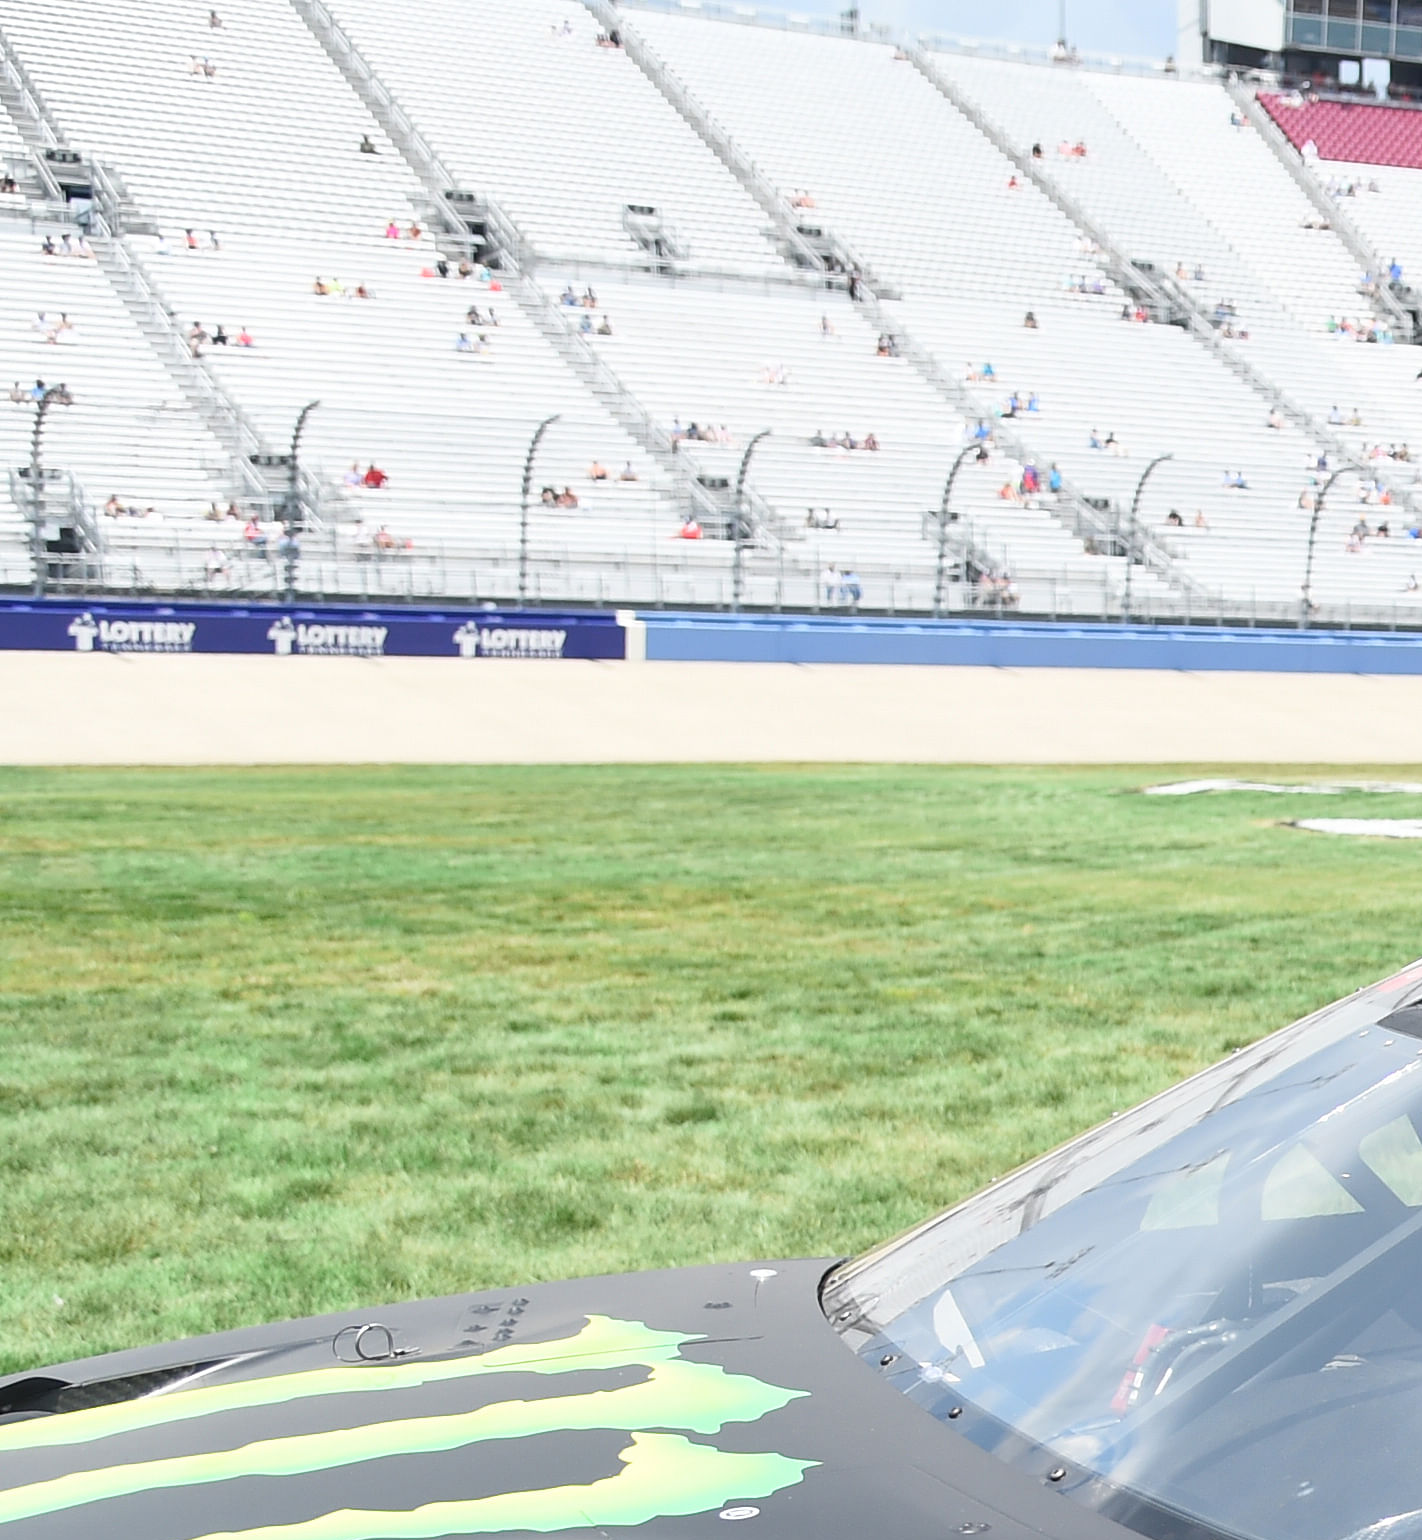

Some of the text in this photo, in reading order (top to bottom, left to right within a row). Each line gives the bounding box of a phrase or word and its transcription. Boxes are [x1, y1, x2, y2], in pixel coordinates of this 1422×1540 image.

[100, 620, 197, 645] LOTTERY
[297, 624, 388, 648] LOTTERY
[481, 628, 567, 651] LOTTERY
